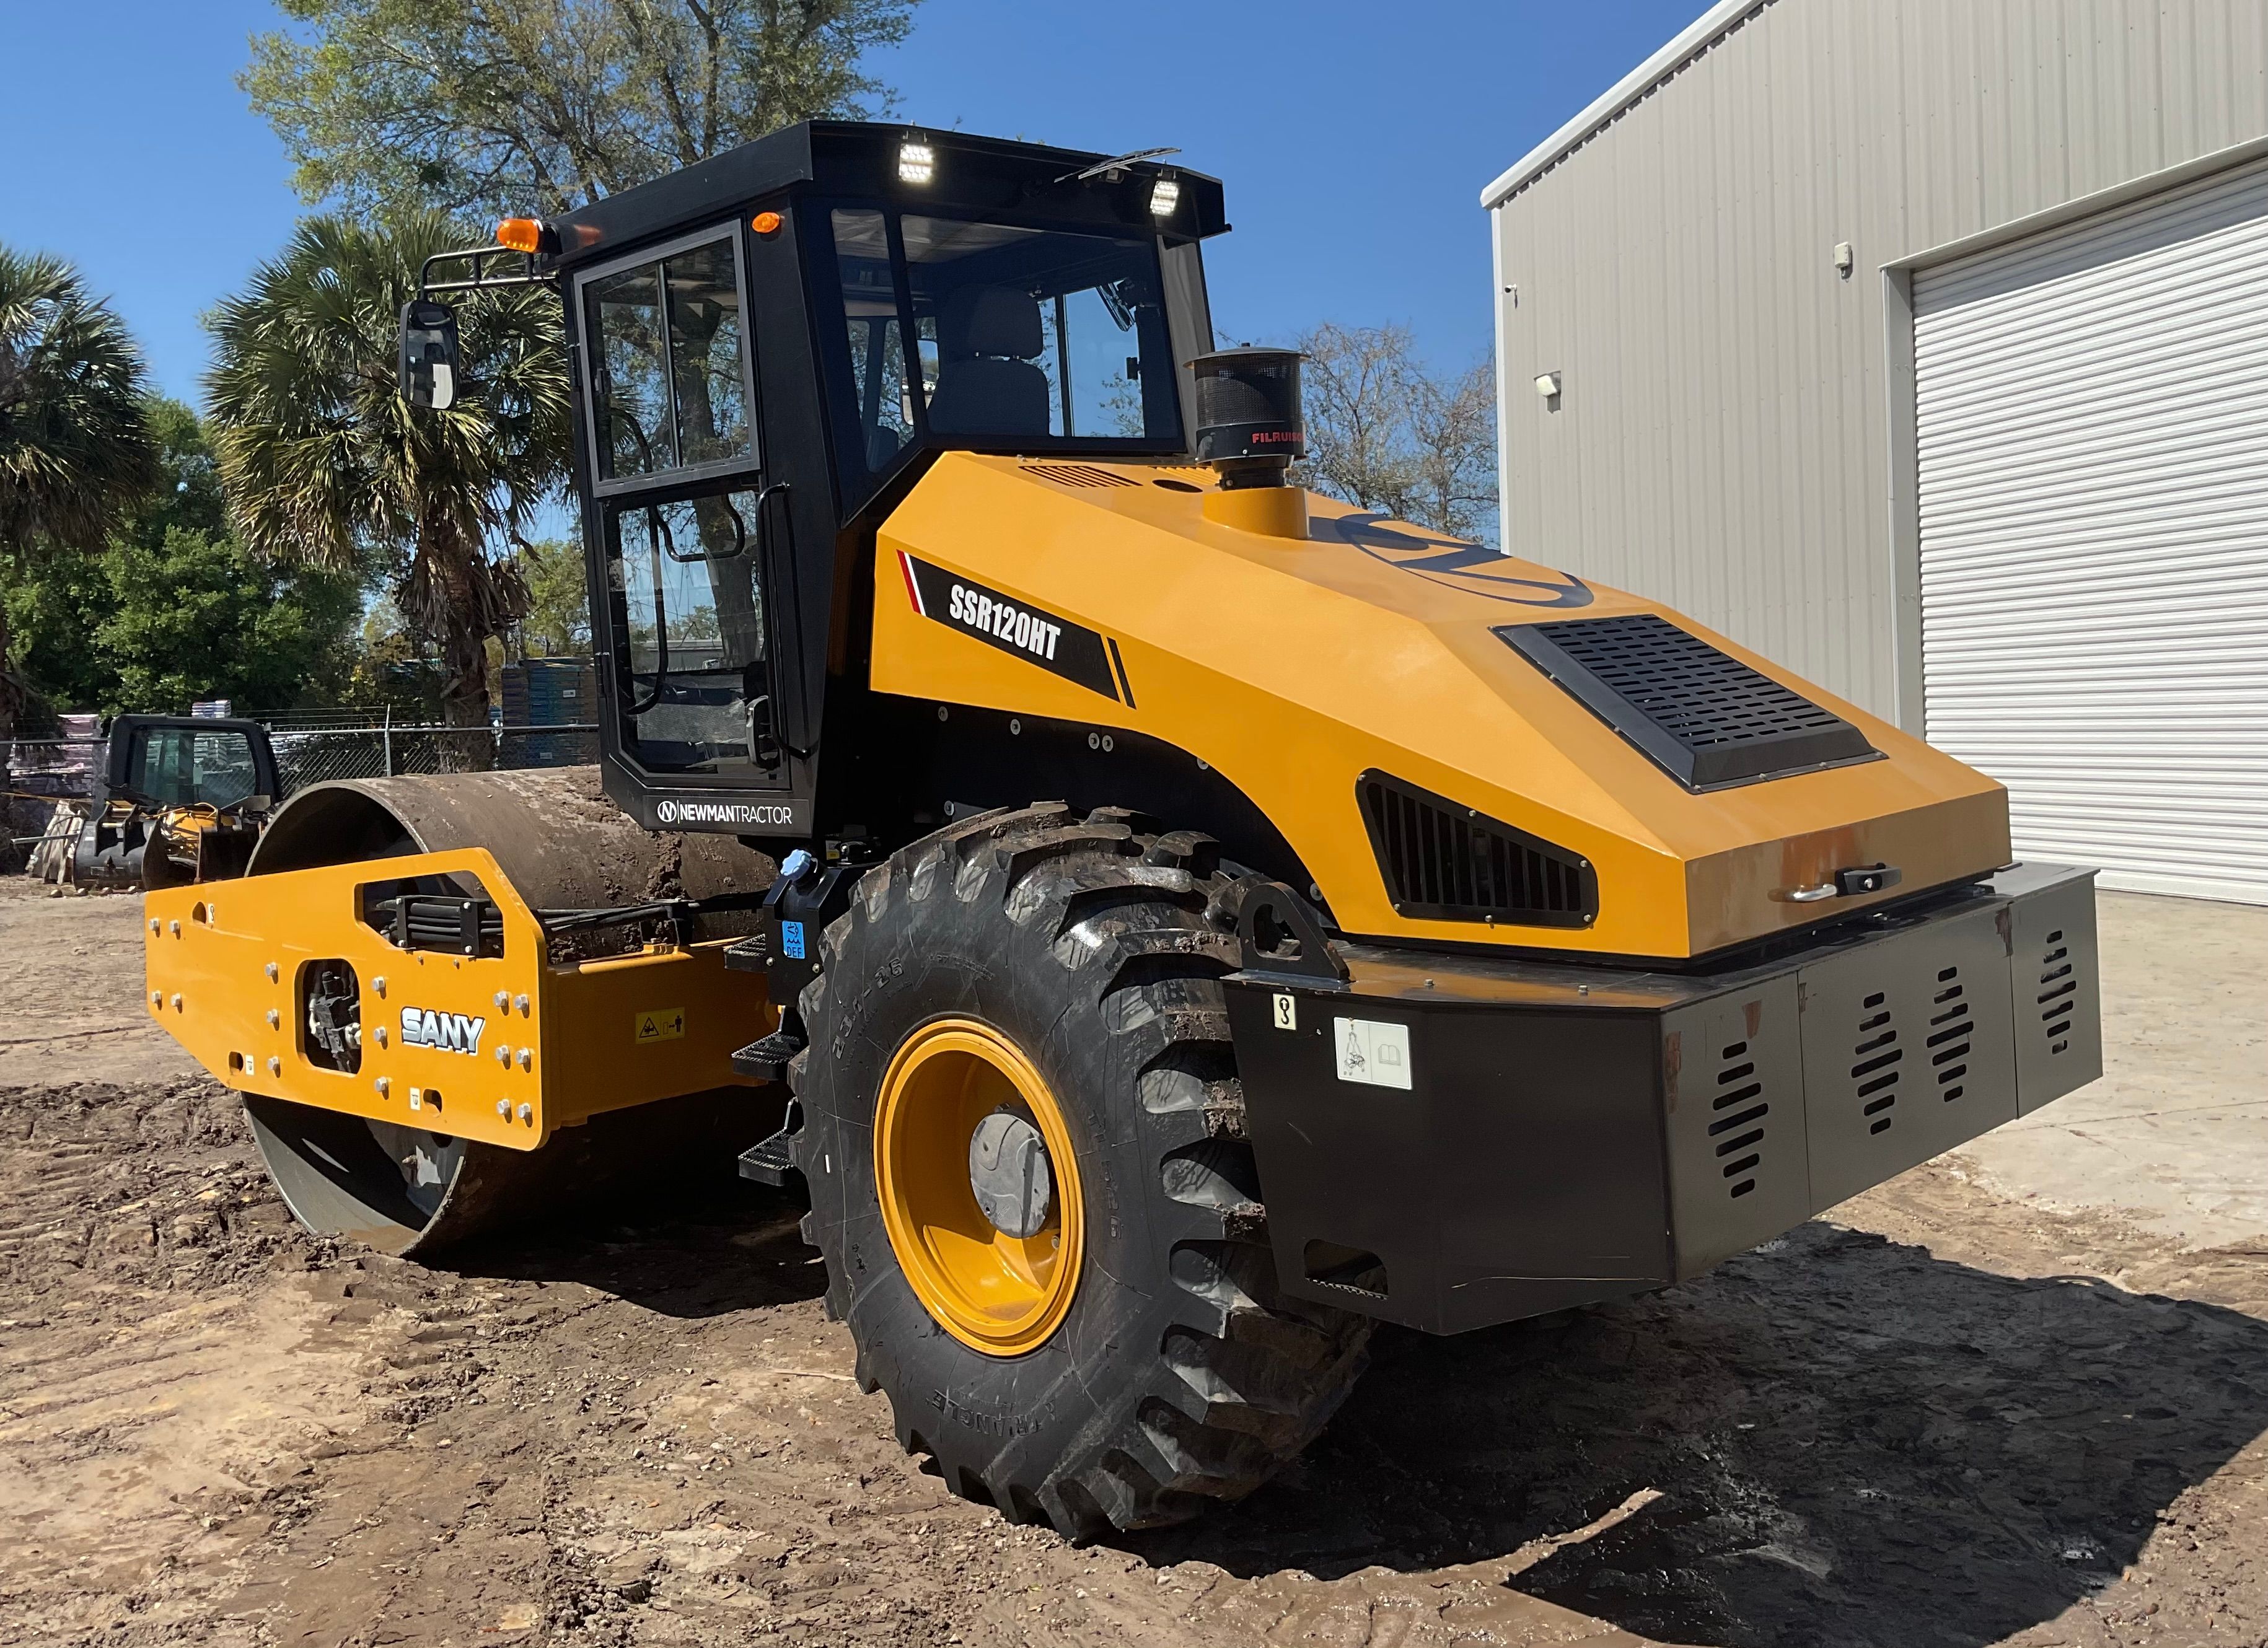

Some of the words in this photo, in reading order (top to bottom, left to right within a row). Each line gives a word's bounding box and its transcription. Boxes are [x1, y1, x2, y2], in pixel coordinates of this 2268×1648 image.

[949, 584, 1061, 660] SSR120HT
[680, 803, 792, 825] NEWMANTRACTOR
[786, 946, 802, 957] DEF
[401, 1006, 486, 1056] SANY
[931, 1389, 1043, 1438] TRIANGLE
